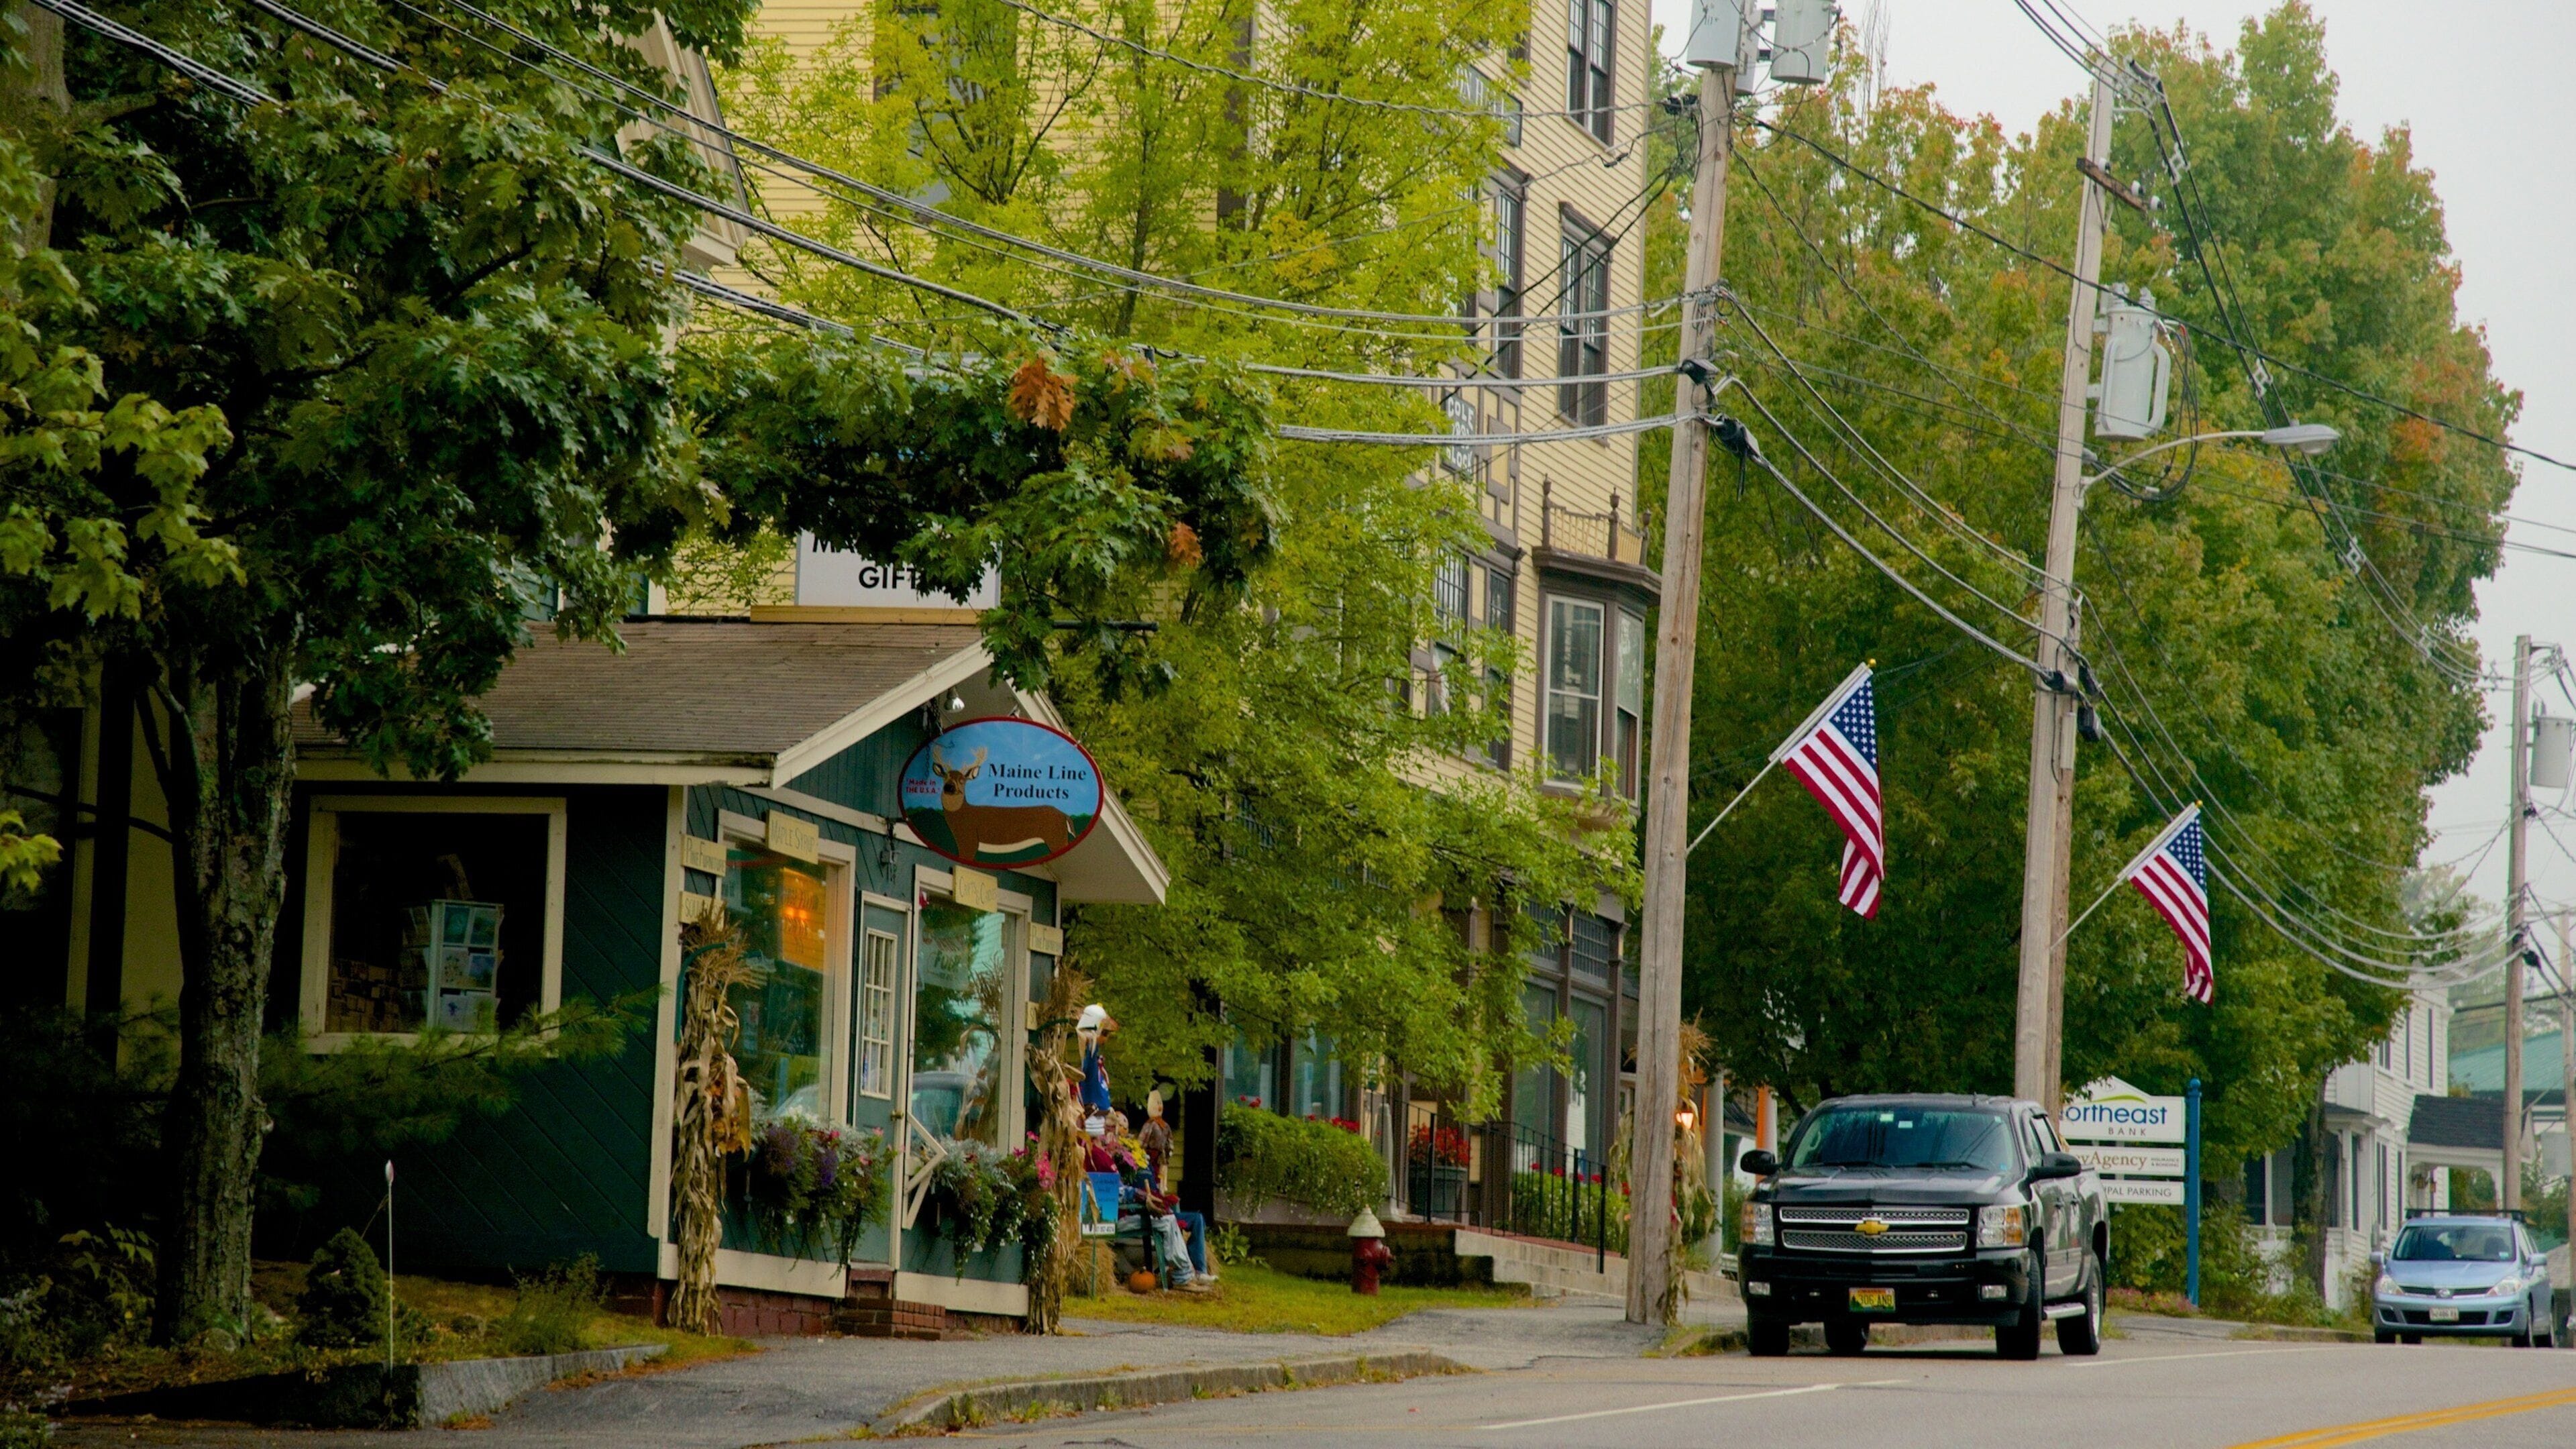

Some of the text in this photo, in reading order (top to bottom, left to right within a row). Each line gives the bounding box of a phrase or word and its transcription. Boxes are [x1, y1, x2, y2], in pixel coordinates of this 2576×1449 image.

[859, 566, 916, 589] GIFT
[989, 763, 1087, 781] Maine Line
[994, 783, 1069, 800] Products
[2108, 1126, 2147, 1136] BANK
[2127, 1187, 2171, 1197] PARKING
